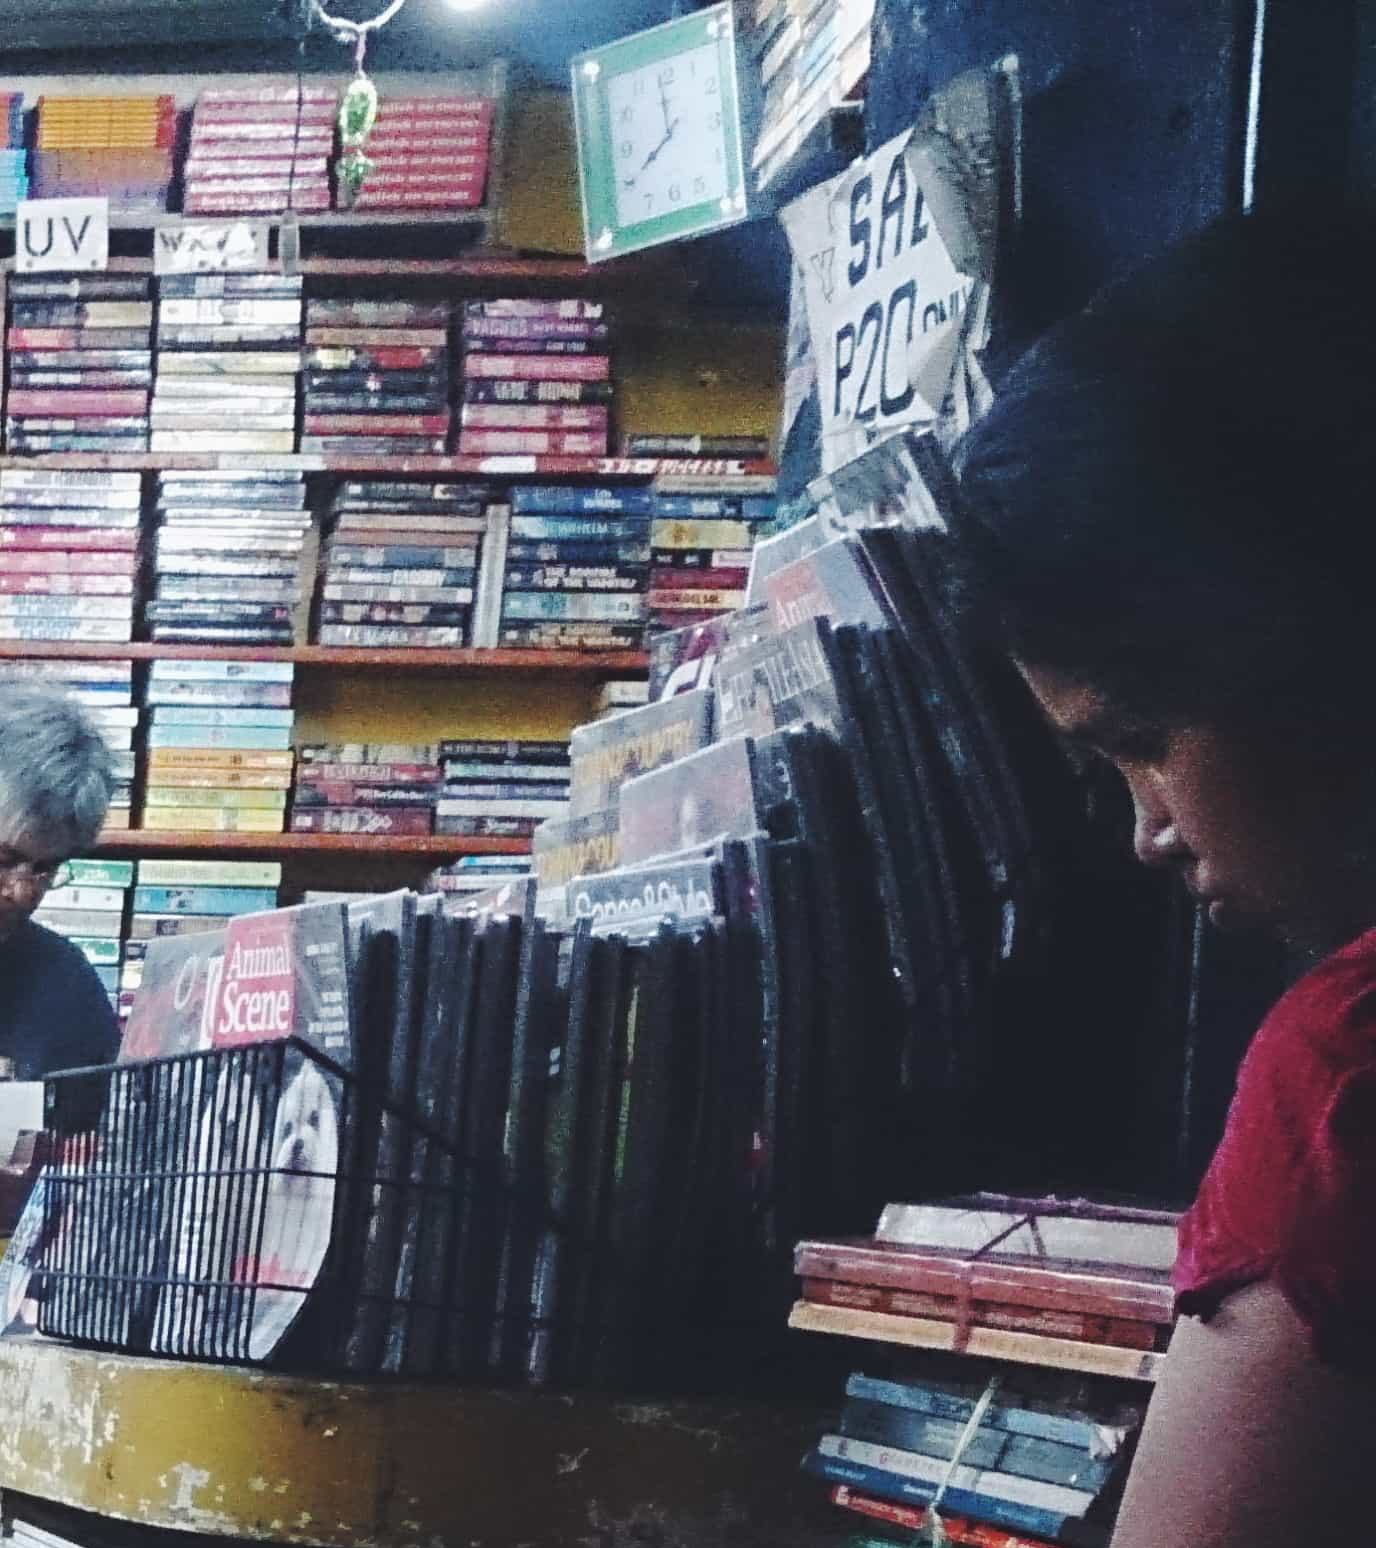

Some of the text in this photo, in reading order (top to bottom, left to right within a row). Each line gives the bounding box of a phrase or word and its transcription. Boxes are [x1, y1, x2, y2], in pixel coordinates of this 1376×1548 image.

[23, 214, 93, 257] UV
[848, 150, 932, 287] SAL
[226, 935, 293, 981] Animal
[218, 981, 292, 1034] Scene
